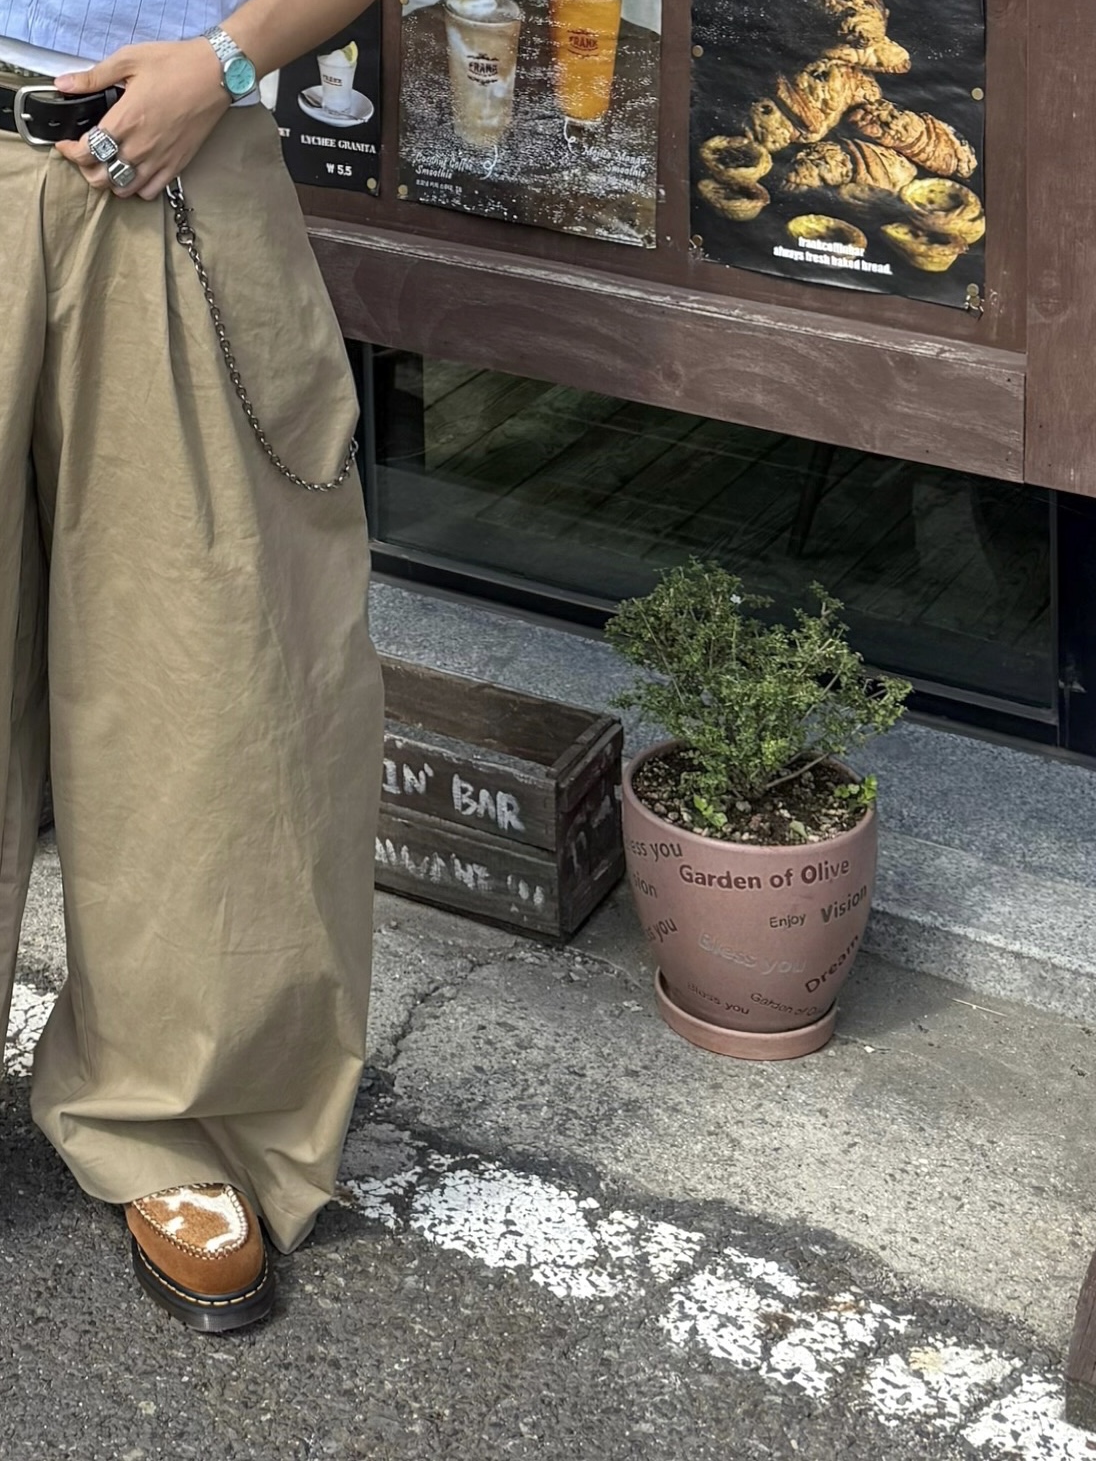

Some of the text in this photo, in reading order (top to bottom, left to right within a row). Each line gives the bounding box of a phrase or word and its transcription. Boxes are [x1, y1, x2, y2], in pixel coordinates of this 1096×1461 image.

[301, 134, 377, 154] LYCHEE GRANITA
[805, 251, 830, 265] fresh
[831, 255, 861, 270] baked
[452, 773, 526, 833] BAR
[649, 842, 683, 863] you
[679, 858, 850, 890] Garden of Olive
[820, 885, 867, 924] Vision
[769, 913, 806, 929] Enjoy
[725, 1002, 751, 1016] you
